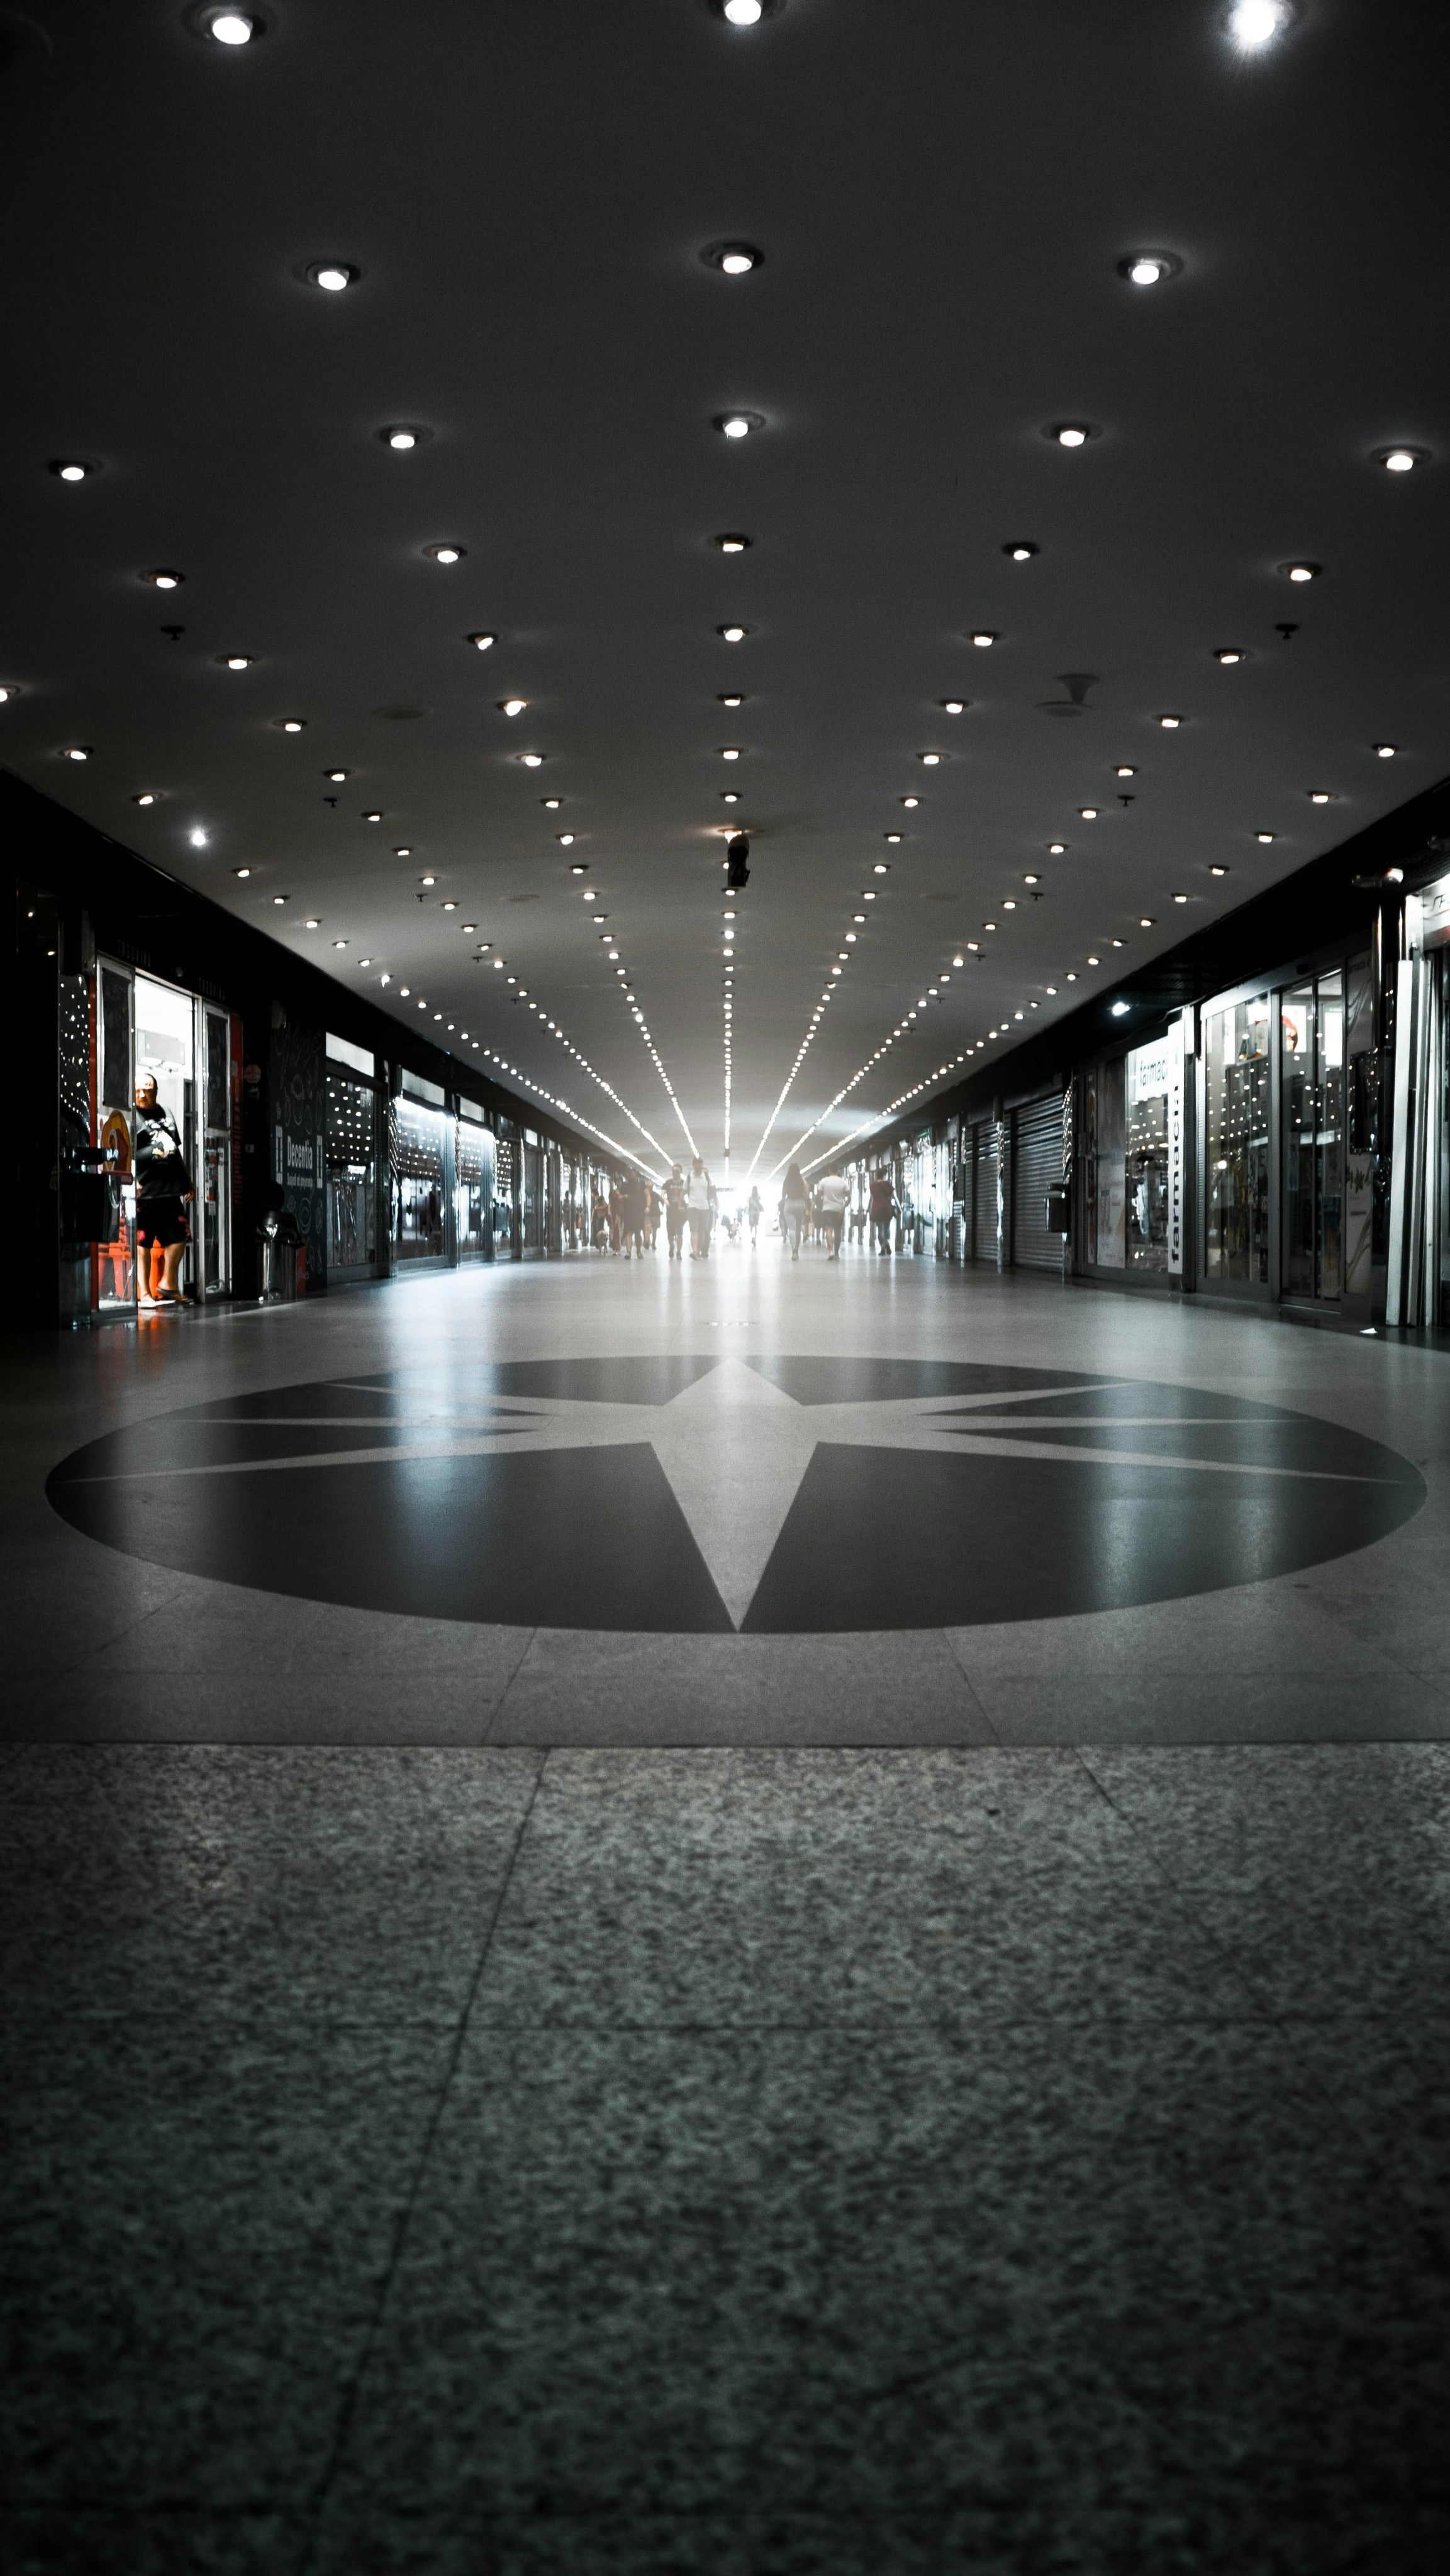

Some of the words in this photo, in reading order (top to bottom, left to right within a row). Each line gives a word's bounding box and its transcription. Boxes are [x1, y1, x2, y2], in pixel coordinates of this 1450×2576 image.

[117, 938, 152, 969] TRGOVINA
[1140, 1059, 1168, 1087] farmac
[287, 1135, 313, 1170] Decentia
